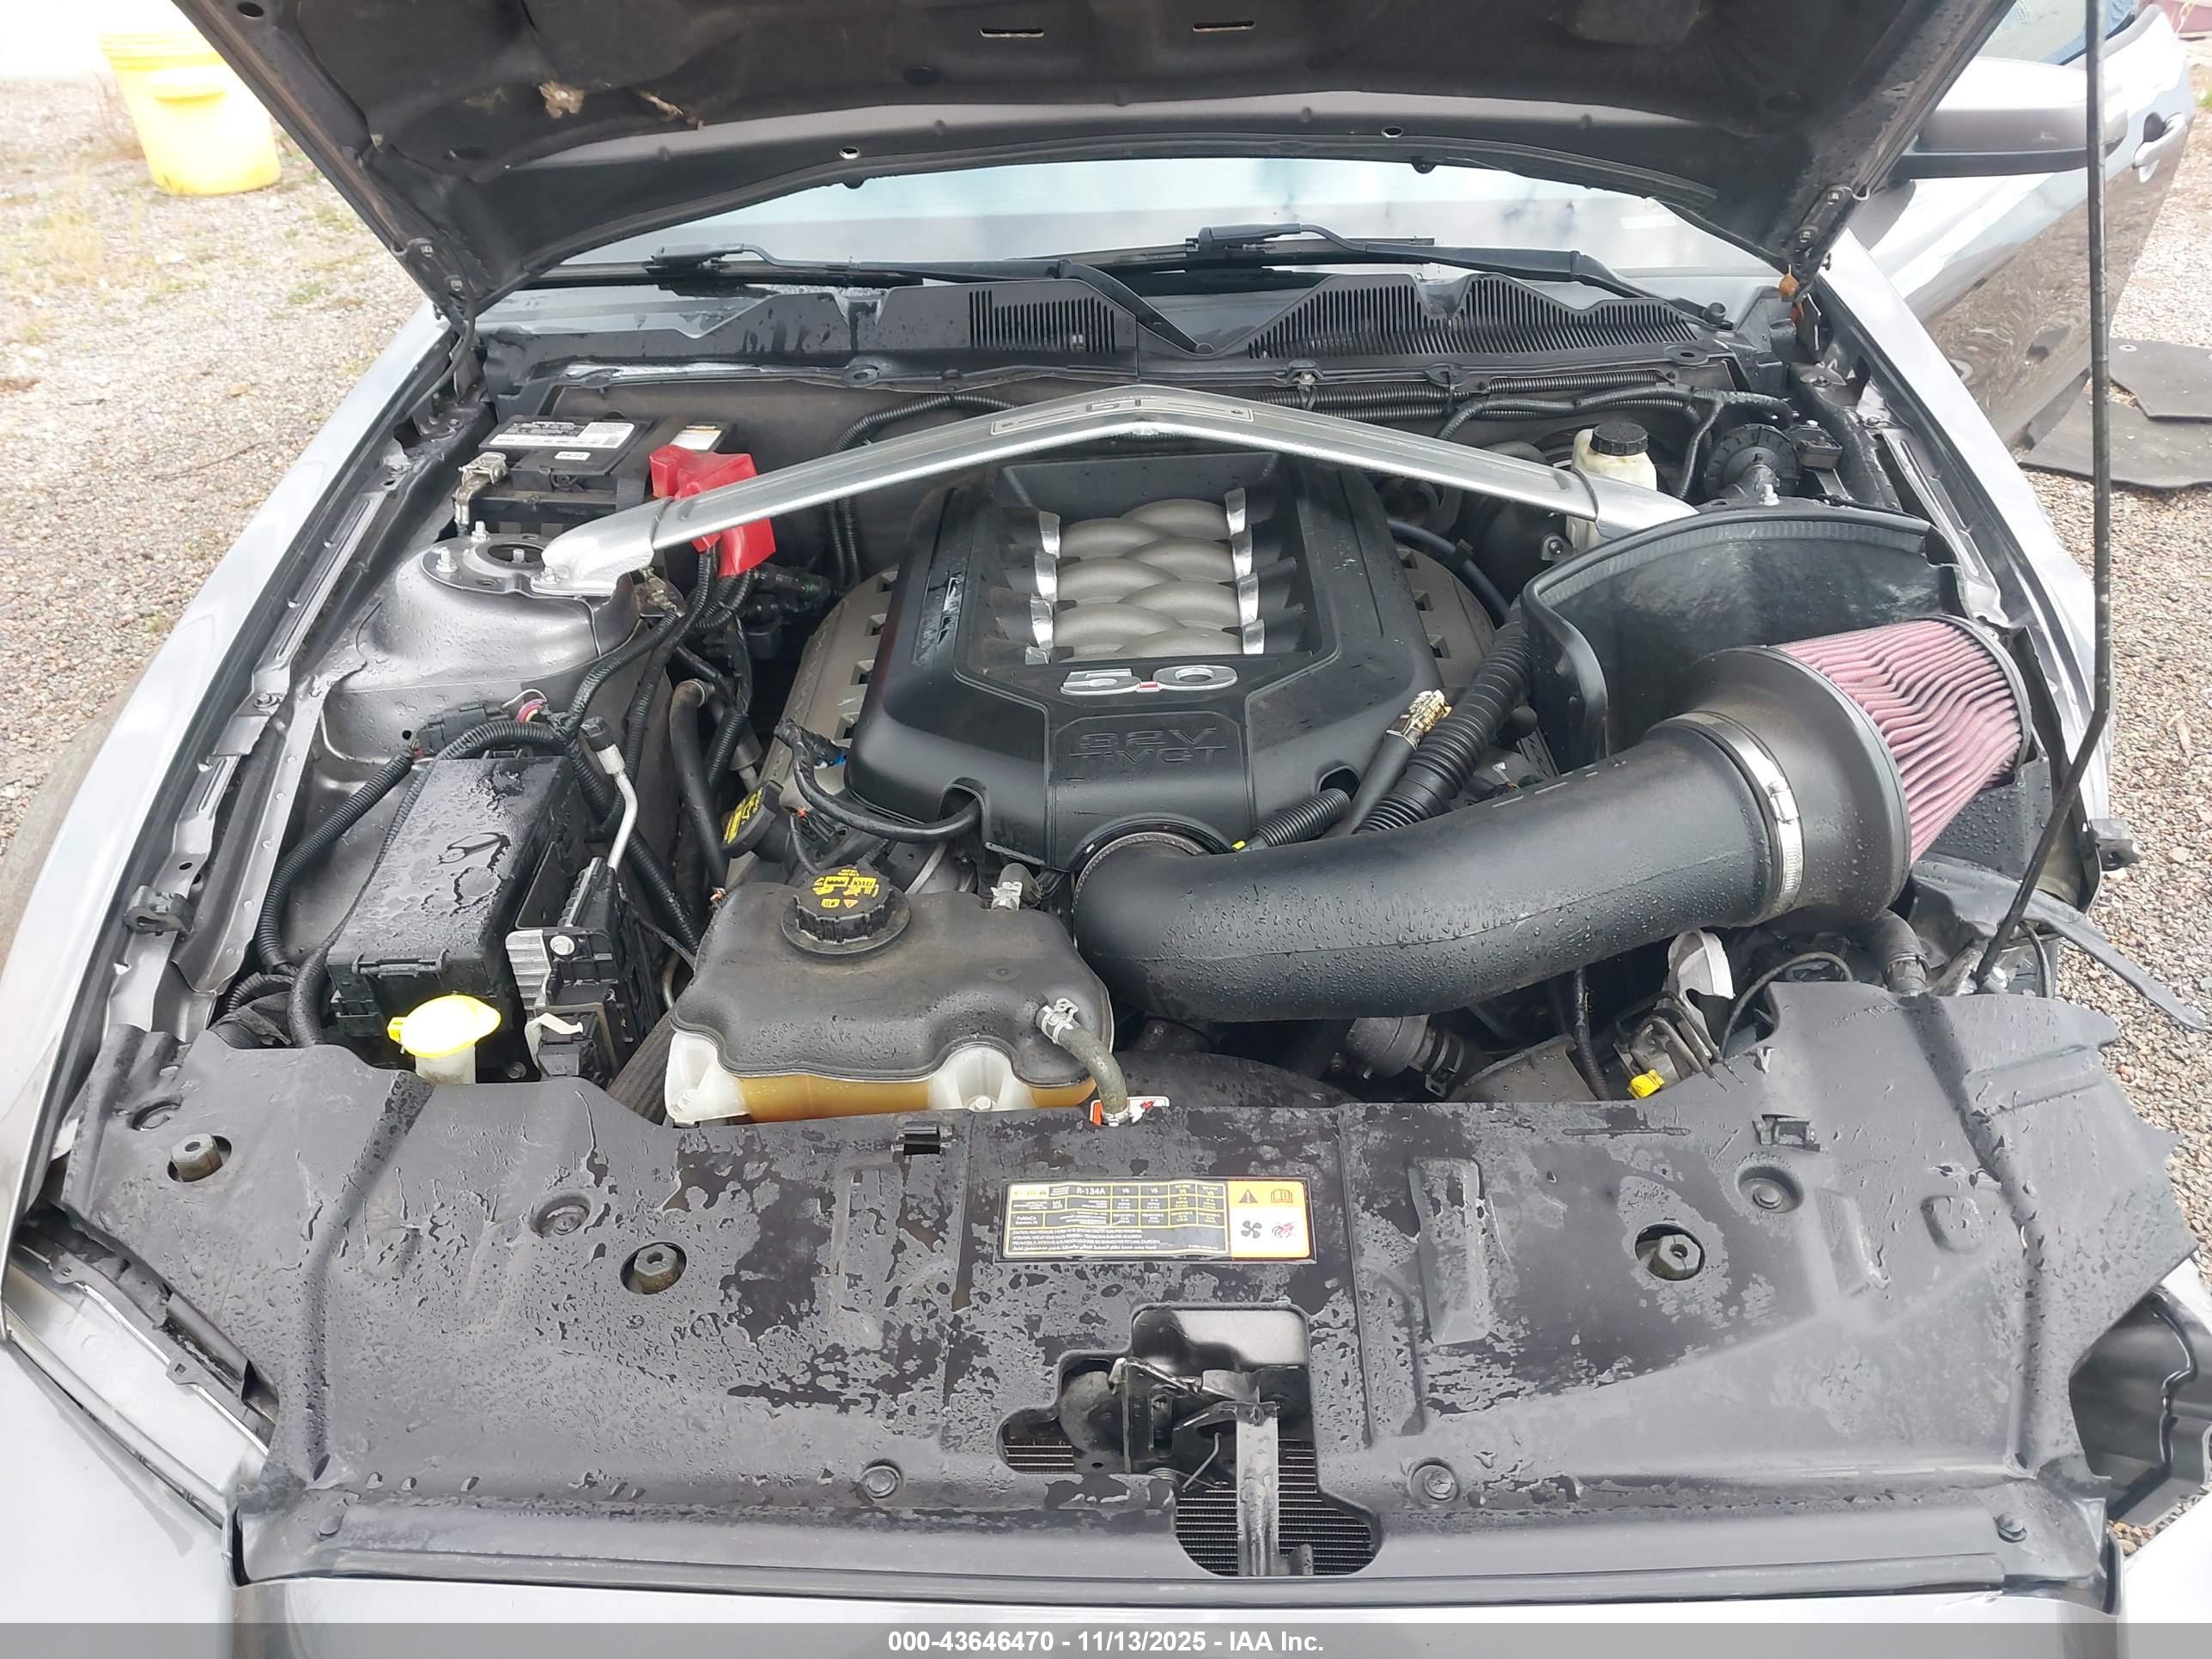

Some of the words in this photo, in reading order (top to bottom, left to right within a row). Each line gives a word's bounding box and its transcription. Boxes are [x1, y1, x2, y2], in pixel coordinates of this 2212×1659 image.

[1060, 665, 1238, 696] 5.0
[1078, 727, 1218, 750] 32V
[1077, 1187, 1106, 1195] R-134A
